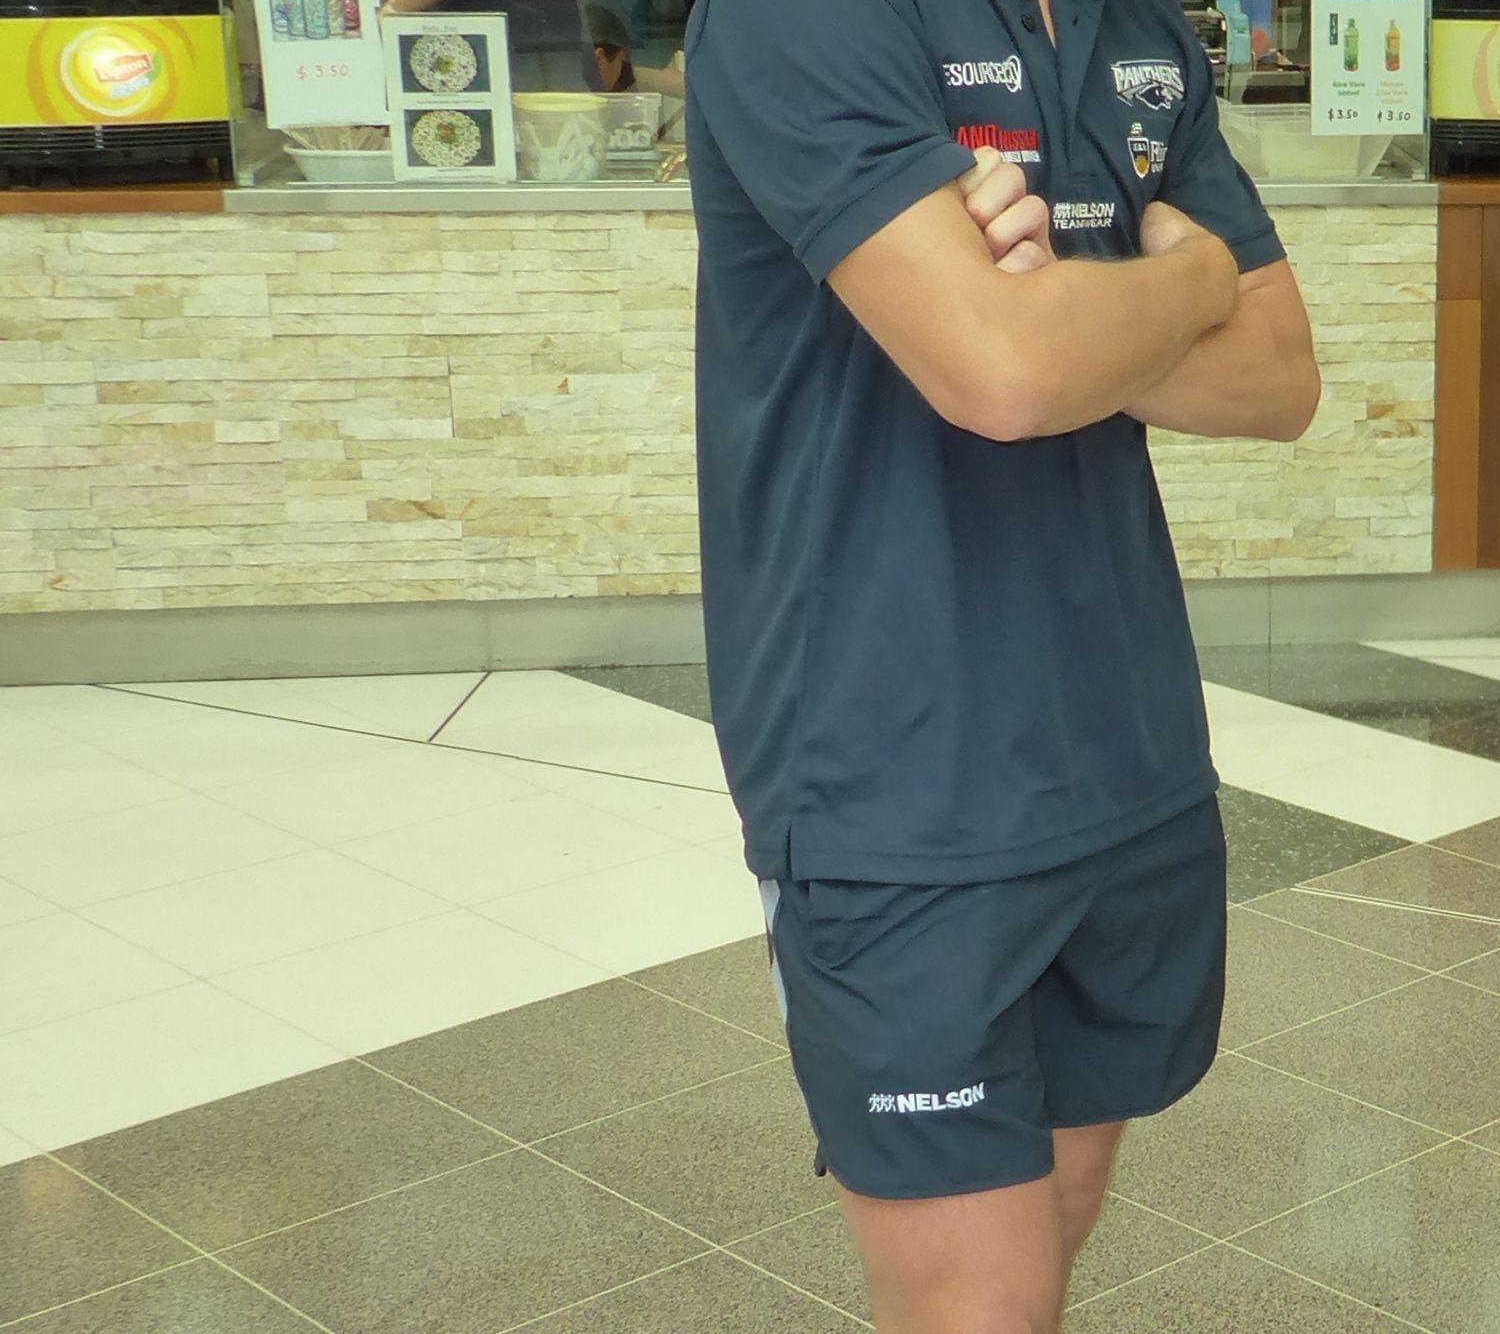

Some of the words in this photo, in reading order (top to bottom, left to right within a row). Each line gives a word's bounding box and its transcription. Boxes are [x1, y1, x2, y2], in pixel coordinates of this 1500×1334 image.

[1112, 64, 1184, 97] PANTHERS
[1071, 202, 1115, 218] NELSON
[897, 1082, 985, 1113] NELSON
